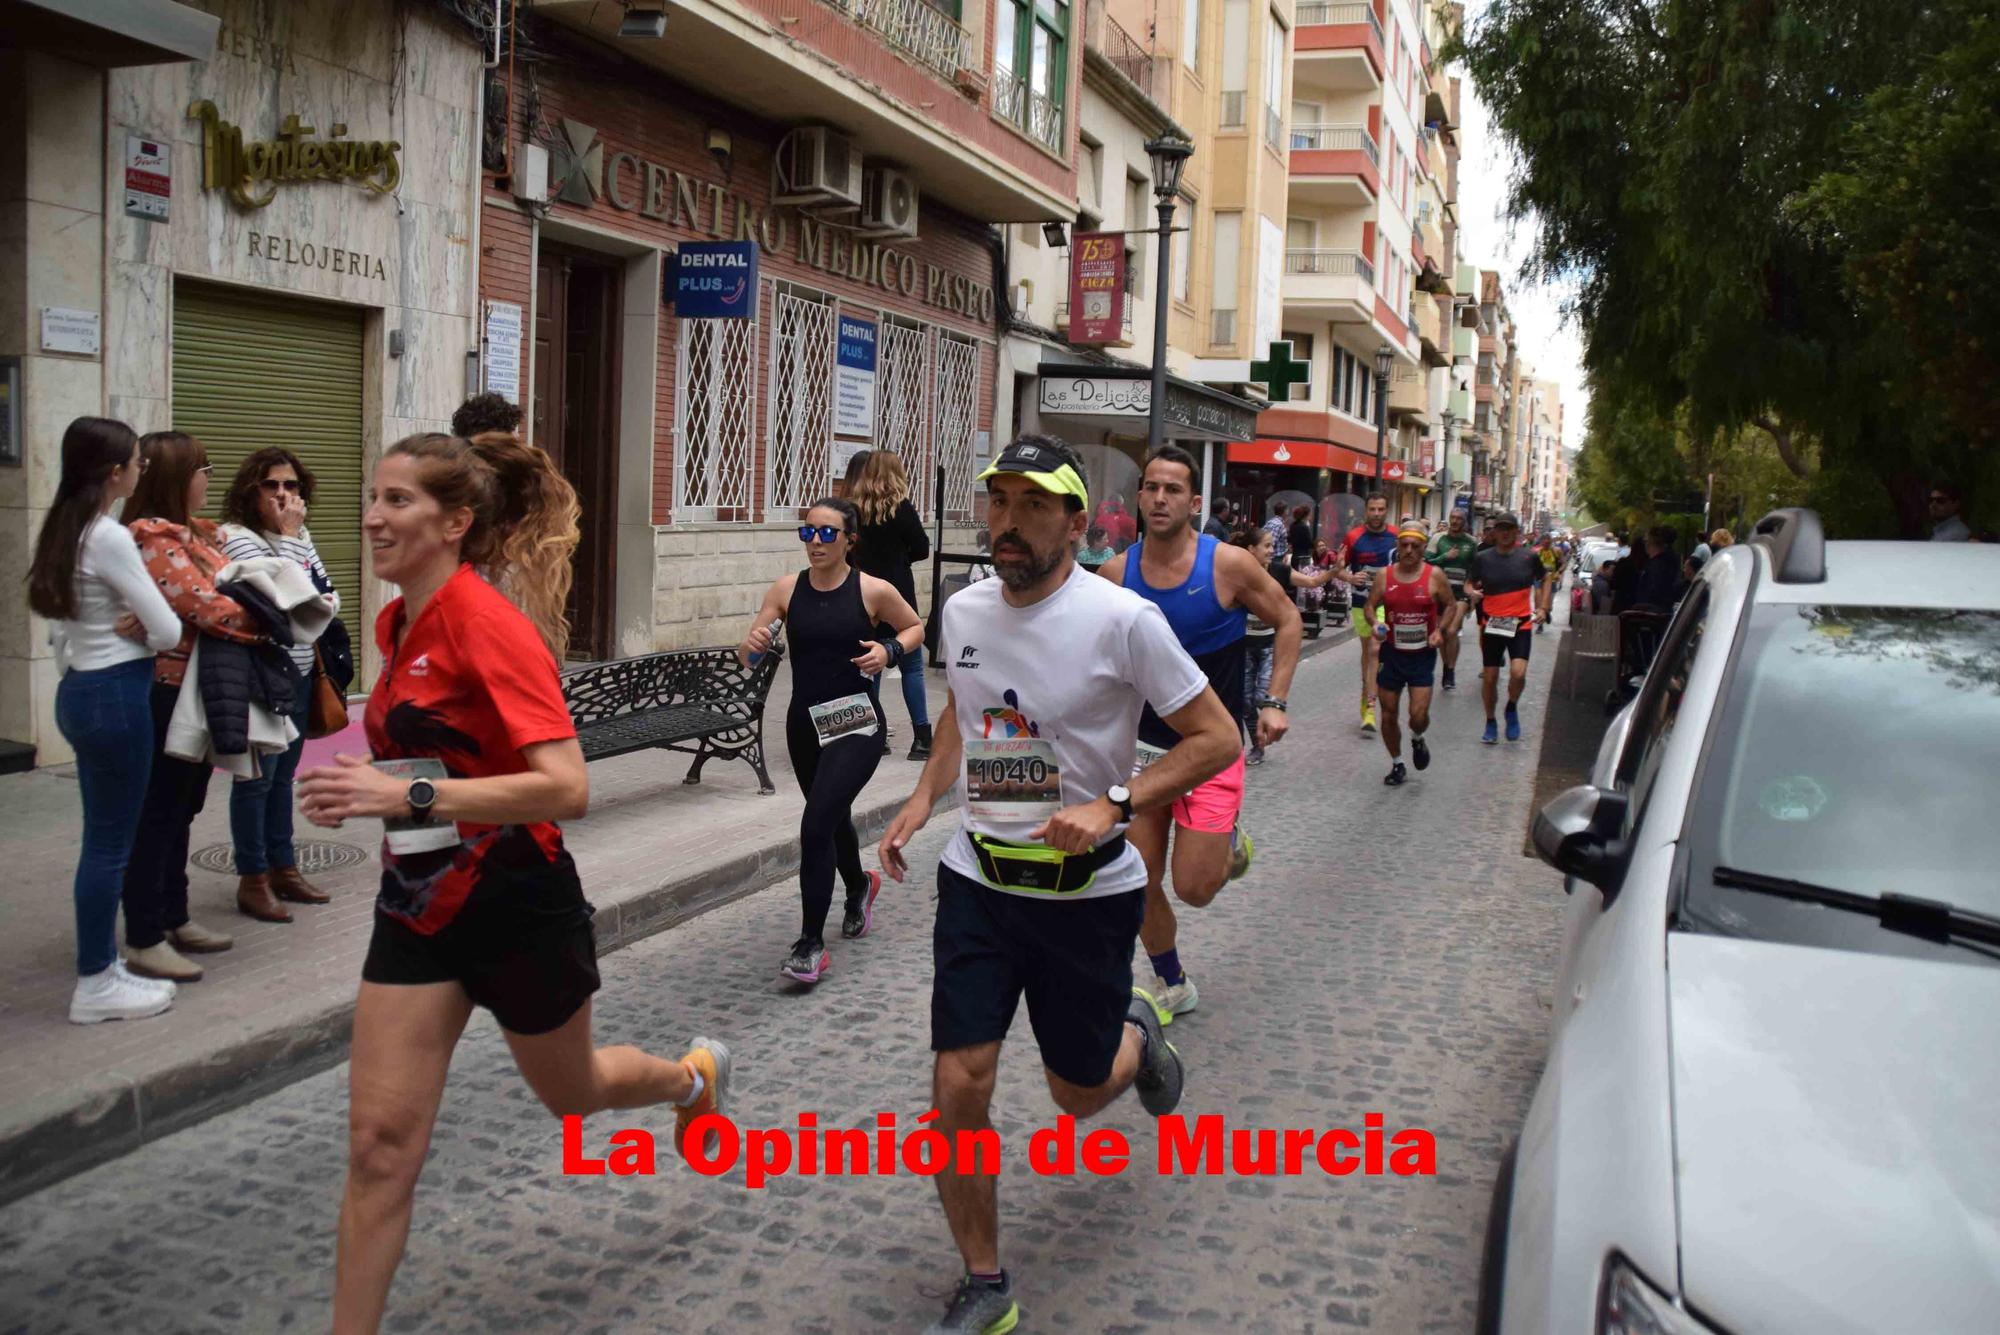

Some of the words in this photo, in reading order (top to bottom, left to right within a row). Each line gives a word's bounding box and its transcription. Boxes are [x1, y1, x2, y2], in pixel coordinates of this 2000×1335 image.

[187, 99, 401, 207] Montesinos
[606, 152, 788, 255] CENTRO
[796, 219, 919, 297] MEDICO
[926, 262, 995, 325] PASEO
[248, 231, 387, 281] RELOJERIA
[681, 254, 748, 267] DENTAL
[679, 278, 722, 291] PLUS
[842, 322, 874, 342] DENTAL
[841, 342, 863, 359] PLUS
[1042, 380, 1067, 409] Las
[1072, 379, 1150, 403] Delicias
[820, 704, 867, 728] 1099
[976, 758, 1048, 785] 1040
